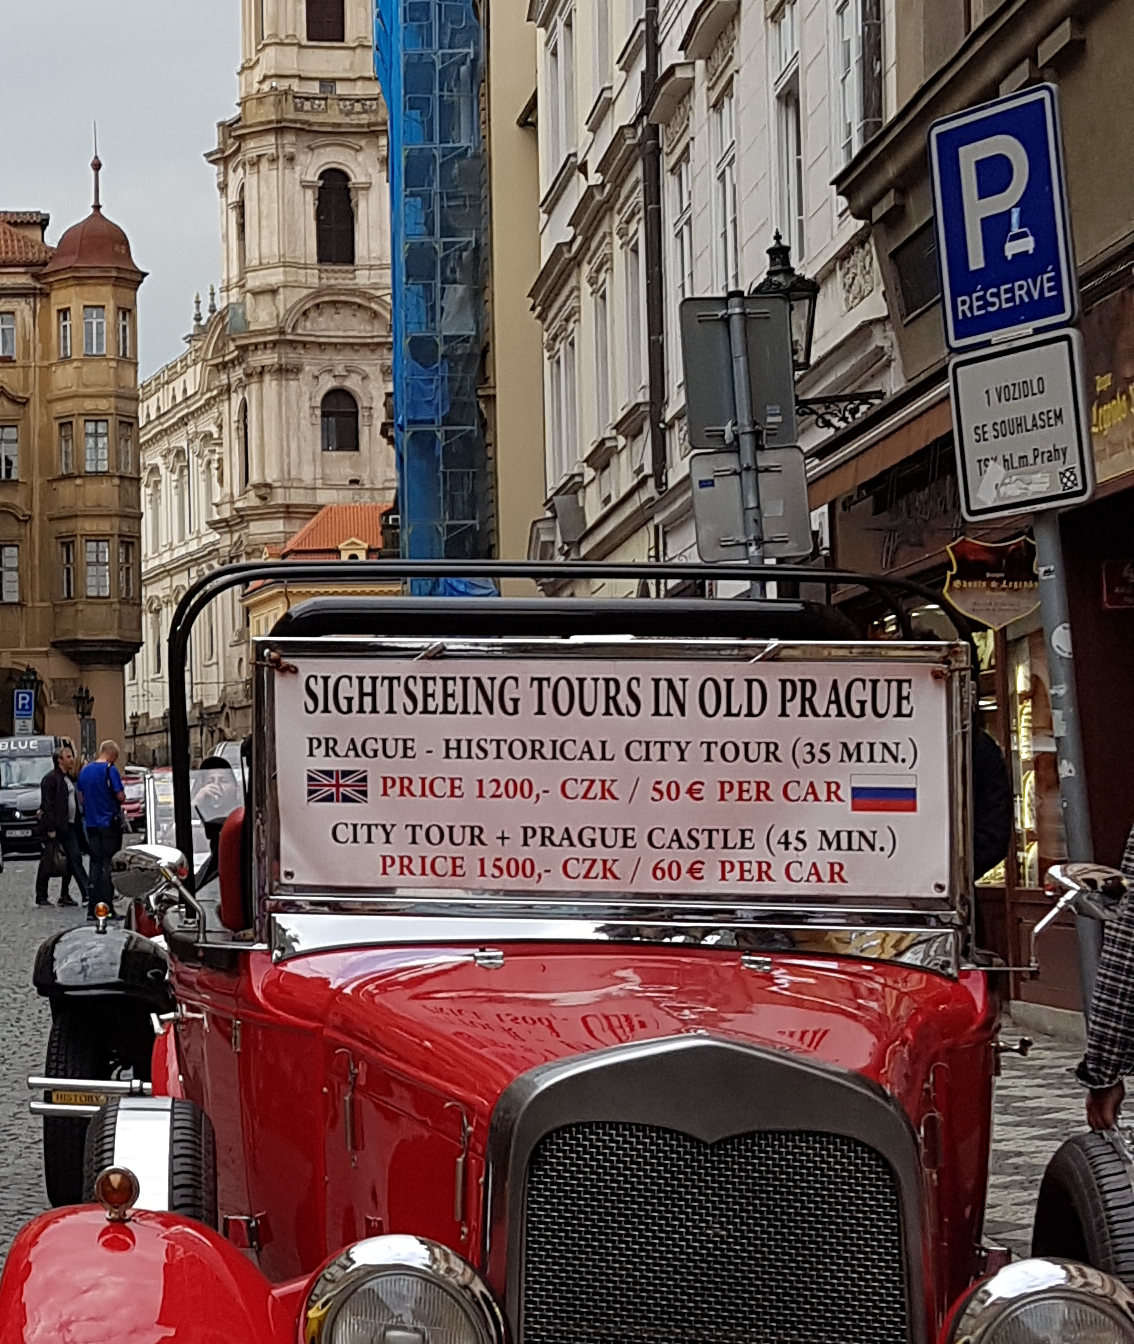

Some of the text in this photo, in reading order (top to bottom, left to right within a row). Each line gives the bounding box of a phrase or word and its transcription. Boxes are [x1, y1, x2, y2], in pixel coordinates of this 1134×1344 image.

[958, 134, 1030, 272] P
[956, 264, 1059, 321] RÉSERVÉ
[984, 376, 1046, 408] 1 VOZIDLO
[973, 407, 1064, 444] SE SOUHLASEM
[303, 674, 915, 720] SIGHTSEEING TOURS IN OLD PRAGUE
[306, 737, 417, 759] PRAGUE
[442, 738, 615, 761] HISTORICAL
[624, 740, 692, 763] CITY
[700, 741, 783, 764] TOUR
[791, 737, 831, 769] (35
[838, 737, 918, 770] MIN.)
[380, 776, 846, 804] PRICE 1200,- CZK / 50€ PER CAR
[331, 822, 397, 845] CITY
[405, 823, 488, 846] TOUR
[521, 826, 638, 849] PRAGUE
[646, 827, 756, 850] CASTLE
[765, 824, 808, 857] (45
[817, 825, 898, 859] MIN.)
[380, 855, 849, 884] PRICE 1500,- CZK / 60€ PER CAR
[55, 1092, 100, 1104] HISTORY
